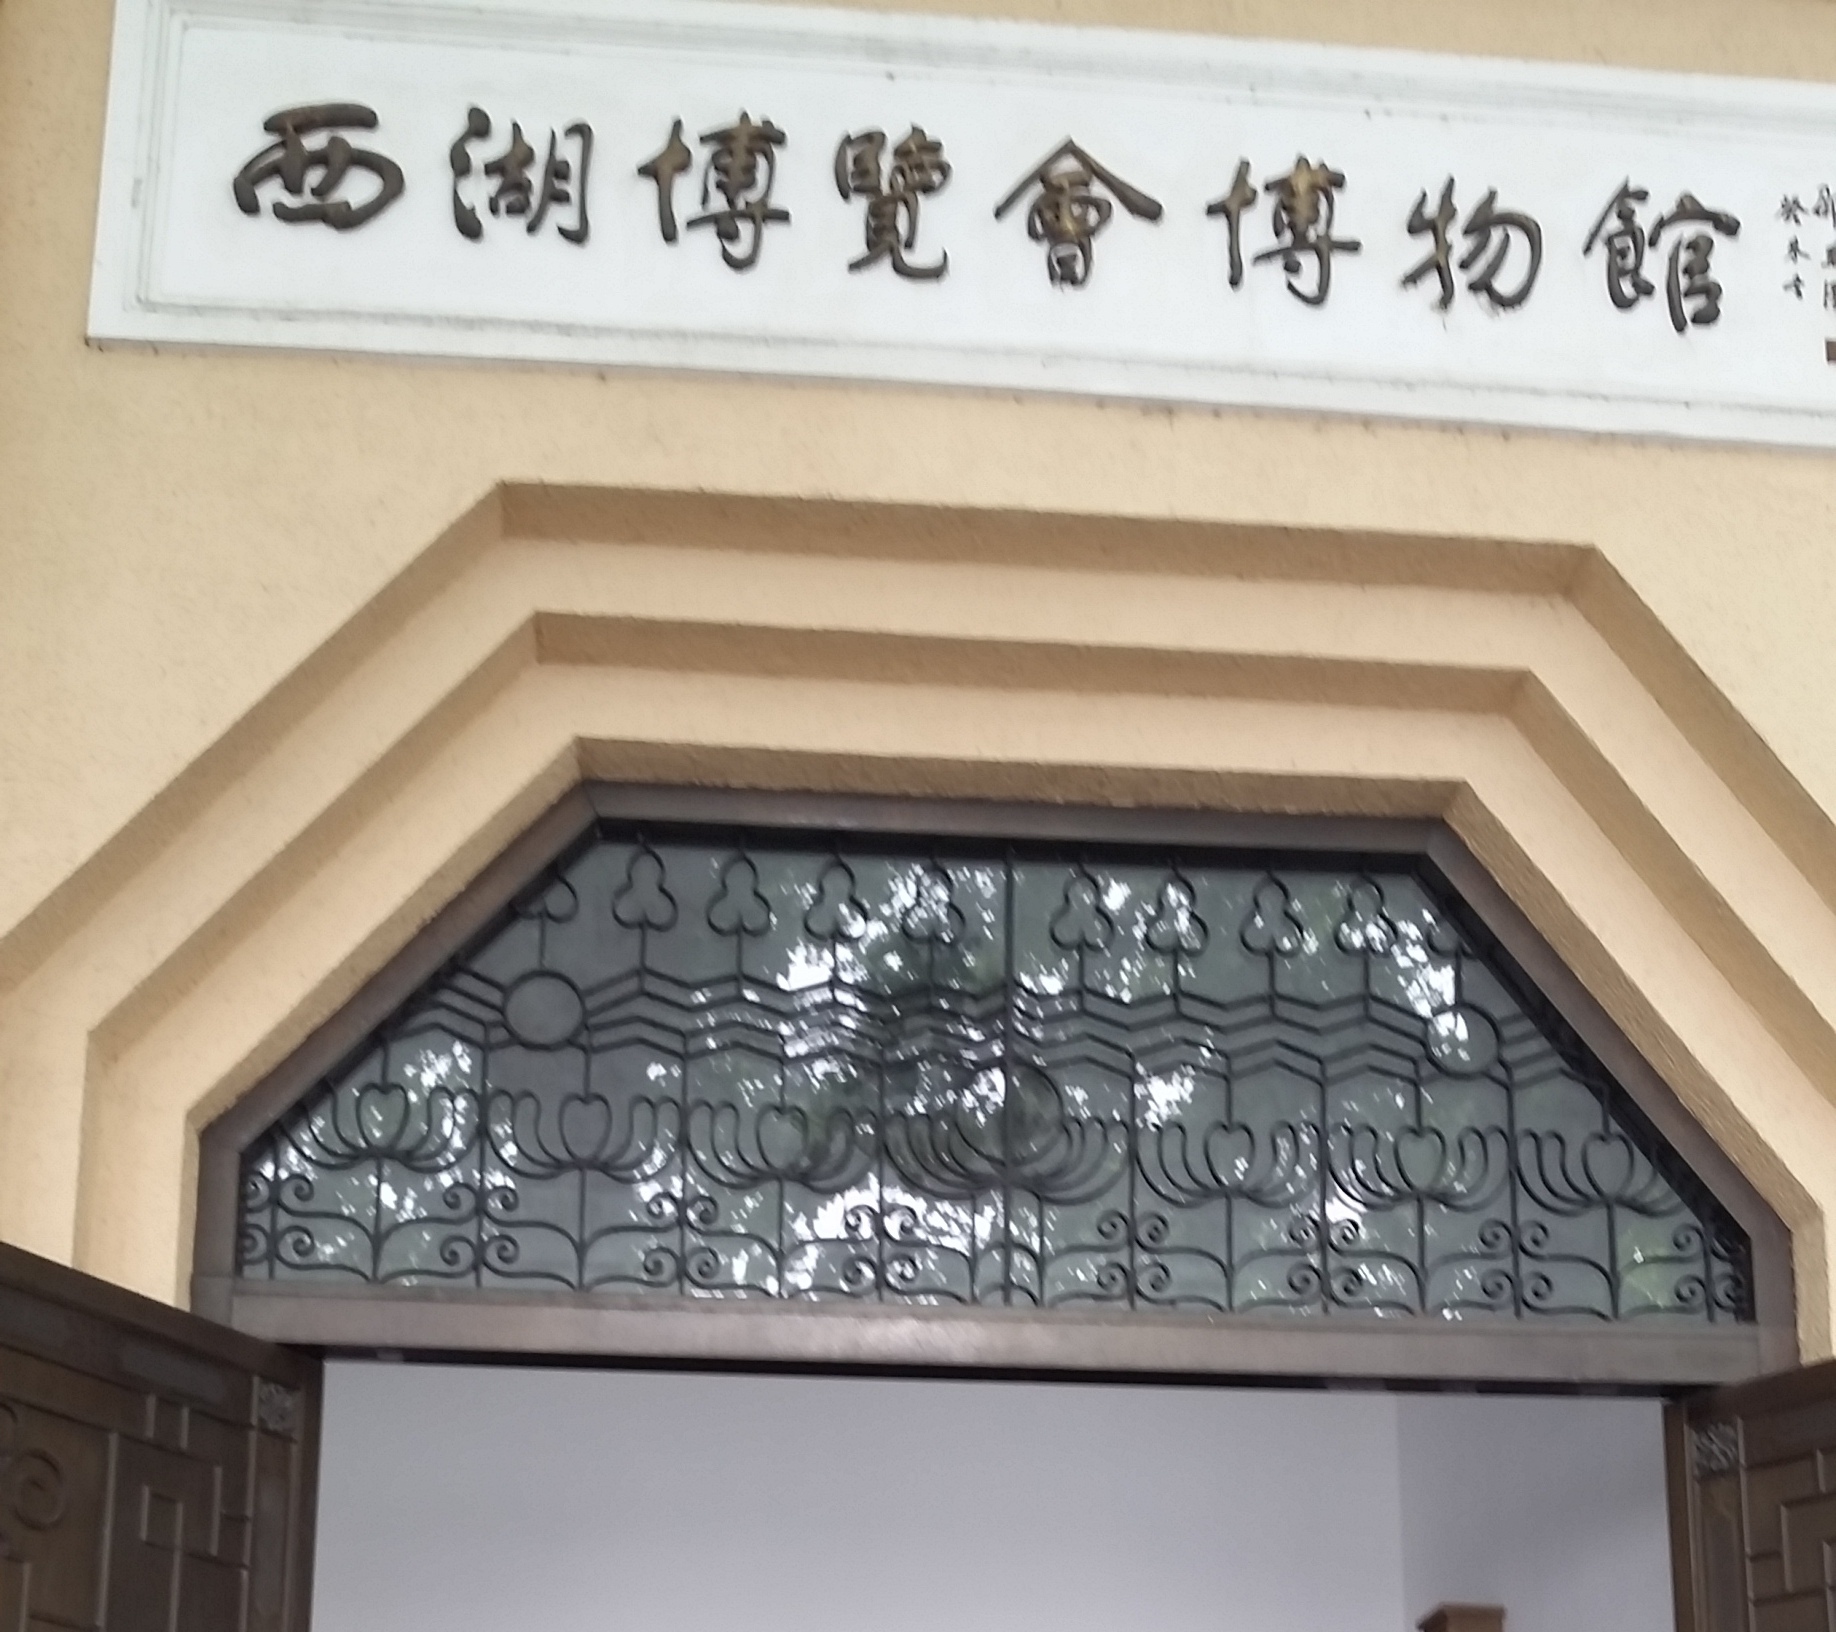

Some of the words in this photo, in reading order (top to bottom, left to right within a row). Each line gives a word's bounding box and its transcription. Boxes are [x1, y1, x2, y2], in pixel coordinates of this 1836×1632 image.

[233, 101, 1742, 333] 西湖博覽會博物館
